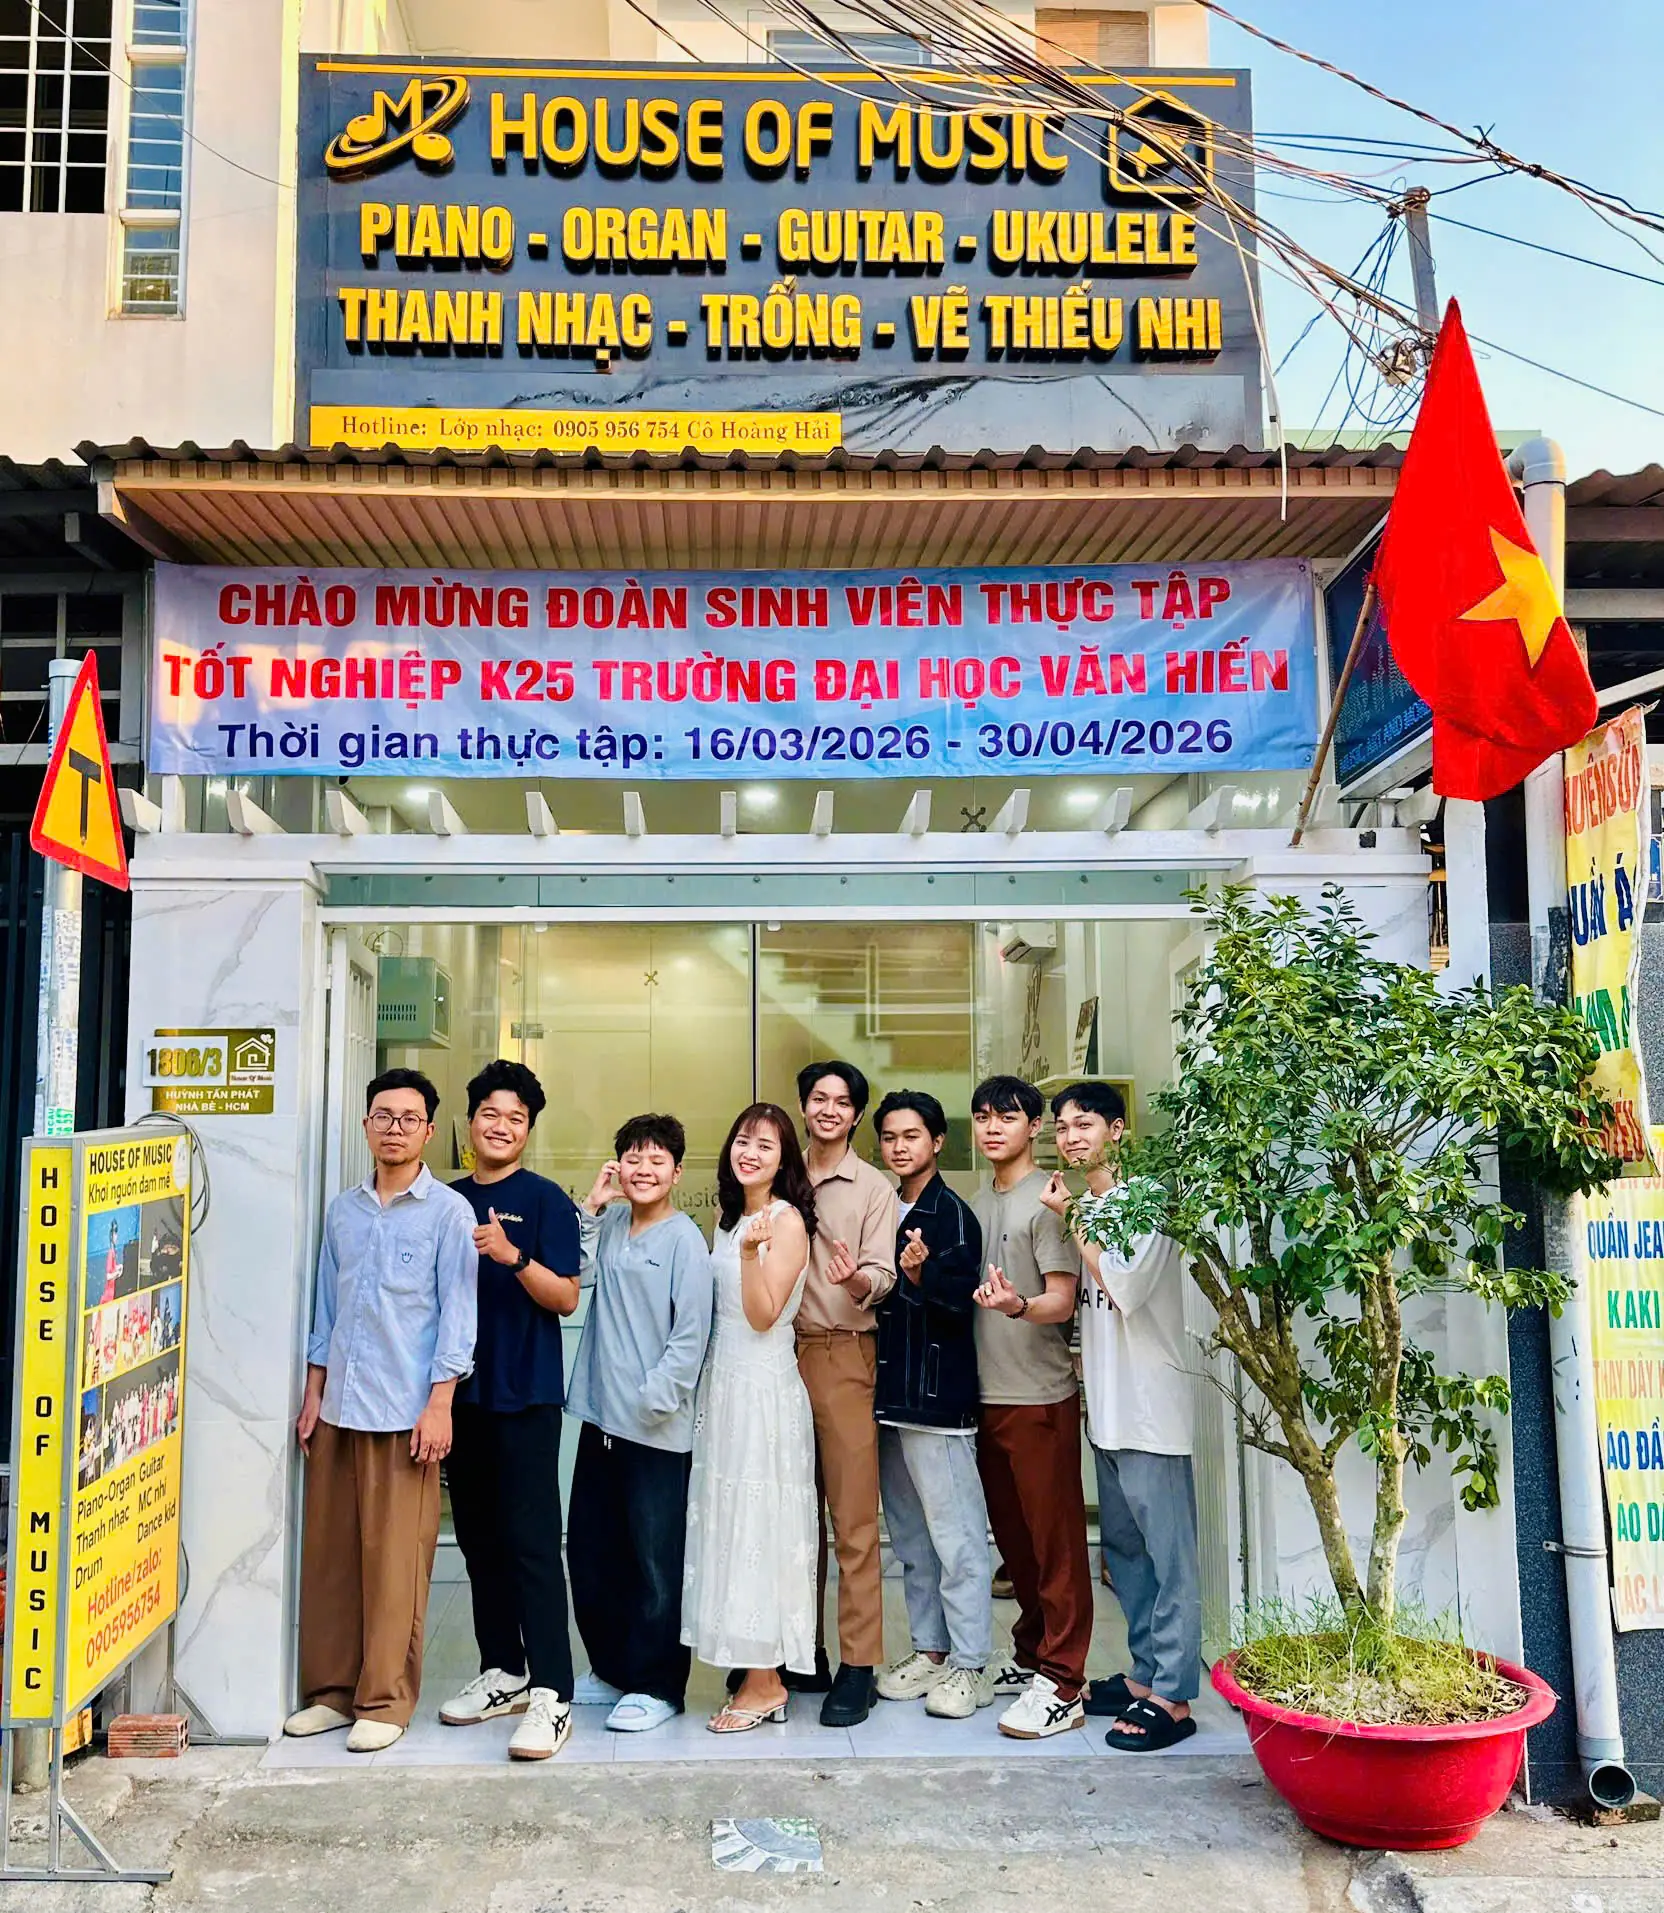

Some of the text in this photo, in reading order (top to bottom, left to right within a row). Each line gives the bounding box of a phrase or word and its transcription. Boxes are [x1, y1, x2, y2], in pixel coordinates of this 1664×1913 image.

[490, 92, 1069, 171] HOUSE OF MUSIC
[360, 203, 514, 261] PIANO
[562, 207, 727, 262] ORGAN
[778, 208, 944, 263] GUITAR
[992, 209, 1198, 265] UKULELE
[338, 287, 503, 345] THANH
[517, 291, 653, 361] NHẠC
[701, 275, 862, 349] TRỐNG
[910, 285, 970, 349] VẼ
[984, 279, 1124, 350] THIẾU
[1136, 297, 1223, 350] NHI
[342, 415, 831, 443] Hotline: Lớp nhạc: 0905 956 754 Cô Hoàng Hải
[218, 571, 1231, 633] CHÀO MỪNG ĐOÀN SINH VIÊN THỰC TẬP
[163, 642, 253, 700] TỐT
[269, 651, 462, 709] NGHIỆP
[481, 659, 573, 702] K25
[592, 651, 797, 703] TRƯỜNG
[813, 659, 899, 710] ĐẠI
[919, 656, 1021, 709] HỌC
[1039, 644, 1147, 697] VĂN
[1165, 637, 1289, 695] HIẾN
[217, 719, 1233, 770] Thời gian thực tập: 16/03/2026 - 30/04/2026
[1614, 852, 1638, 932] Á
[147, 1047, 223, 1077] 1806/3
[176, 1101, 199, 1111] NHÀ
[225, 1102, 249, 1111] HCM
[231, 1088, 260, 1099] PHÁT
[90, 1143, 172, 1175] HOUSE OF MUSIC
[39, 1167, 58, 1341] HOUSE
[1587, 1206, 1630, 1263] QUẦN
[1634, 1220, 1664, 1260] JEA
[1607, 1290, 1661, 1329] KAKI
[35, 1396, 52, 1456] OF
[1607, 1416, 1664, 1471] ÁO ĐẦ
[76, 1477, 167, 1556] Thanh nhạc MC nhi
[77, 1454, 165, 1524] Piano-Organ Guitar
[1617, 1493, 1664, 1542] ÁO D
[137, 1498, 176, 1544] Dance kid
[25, 1511, 50, 1689] MUSIC
[75, 1556, 103, 1590] Drum
[88, 1547, 162, 1625] Hotline/zalo:
[86, 1580, 161, 1669] 0905956754
